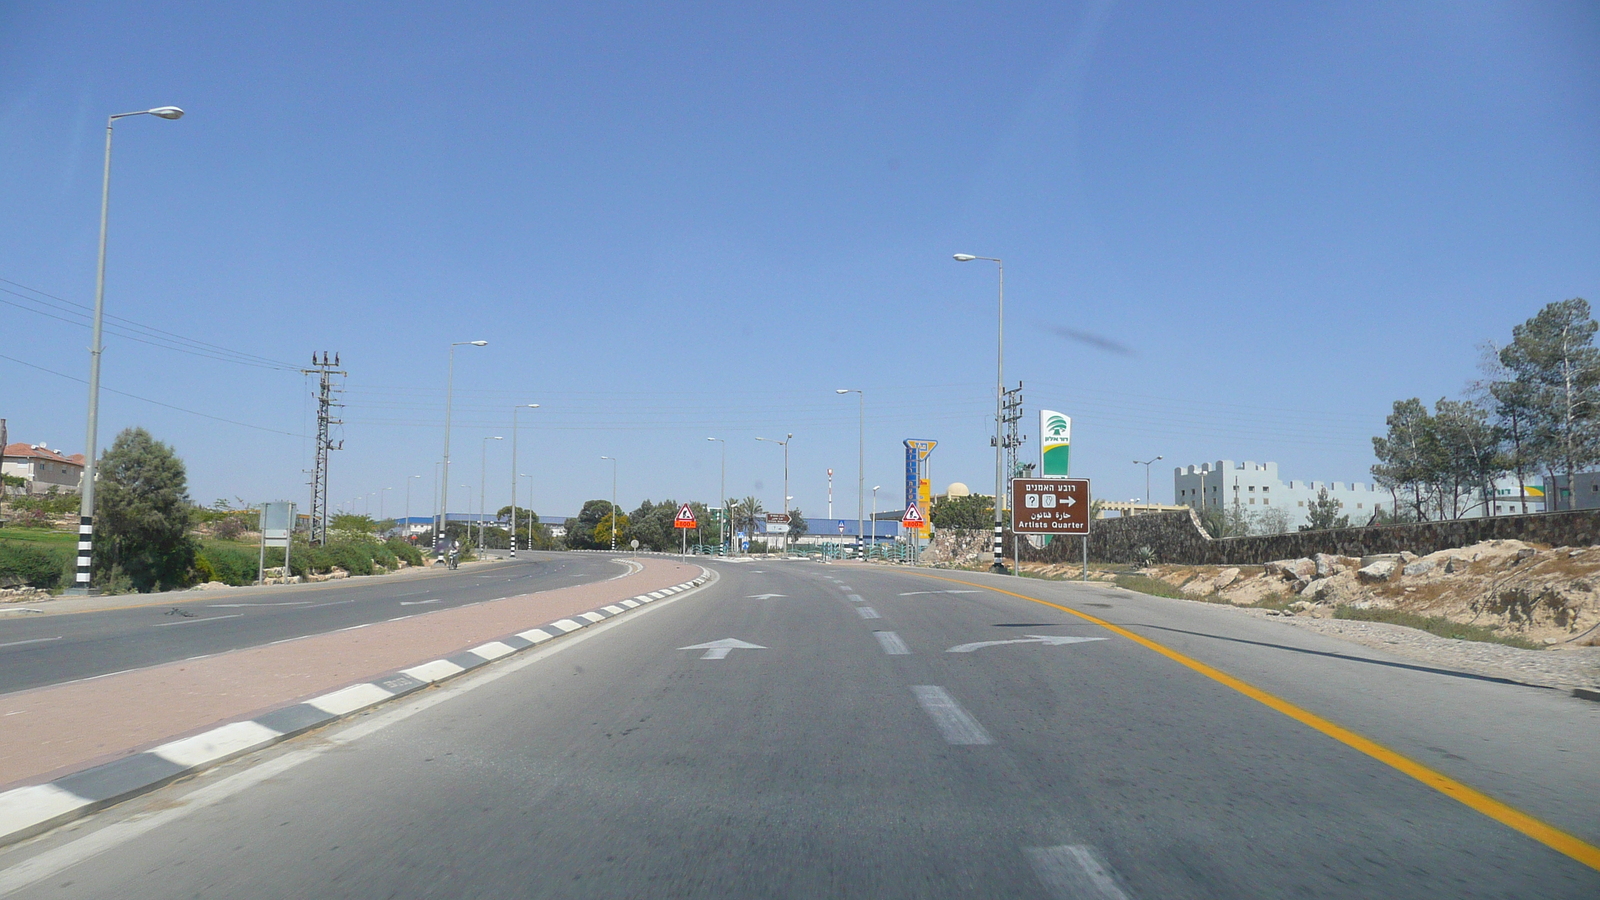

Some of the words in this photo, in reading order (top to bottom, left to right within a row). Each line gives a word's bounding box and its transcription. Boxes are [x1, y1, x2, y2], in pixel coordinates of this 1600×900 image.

[1025, 484, 1055, 492] האמנים
[1058, 484, 1076, 492] רובע
[1055, 512, 1071, 520] حارة
[1051, 521, 1084, 529] Quarter
